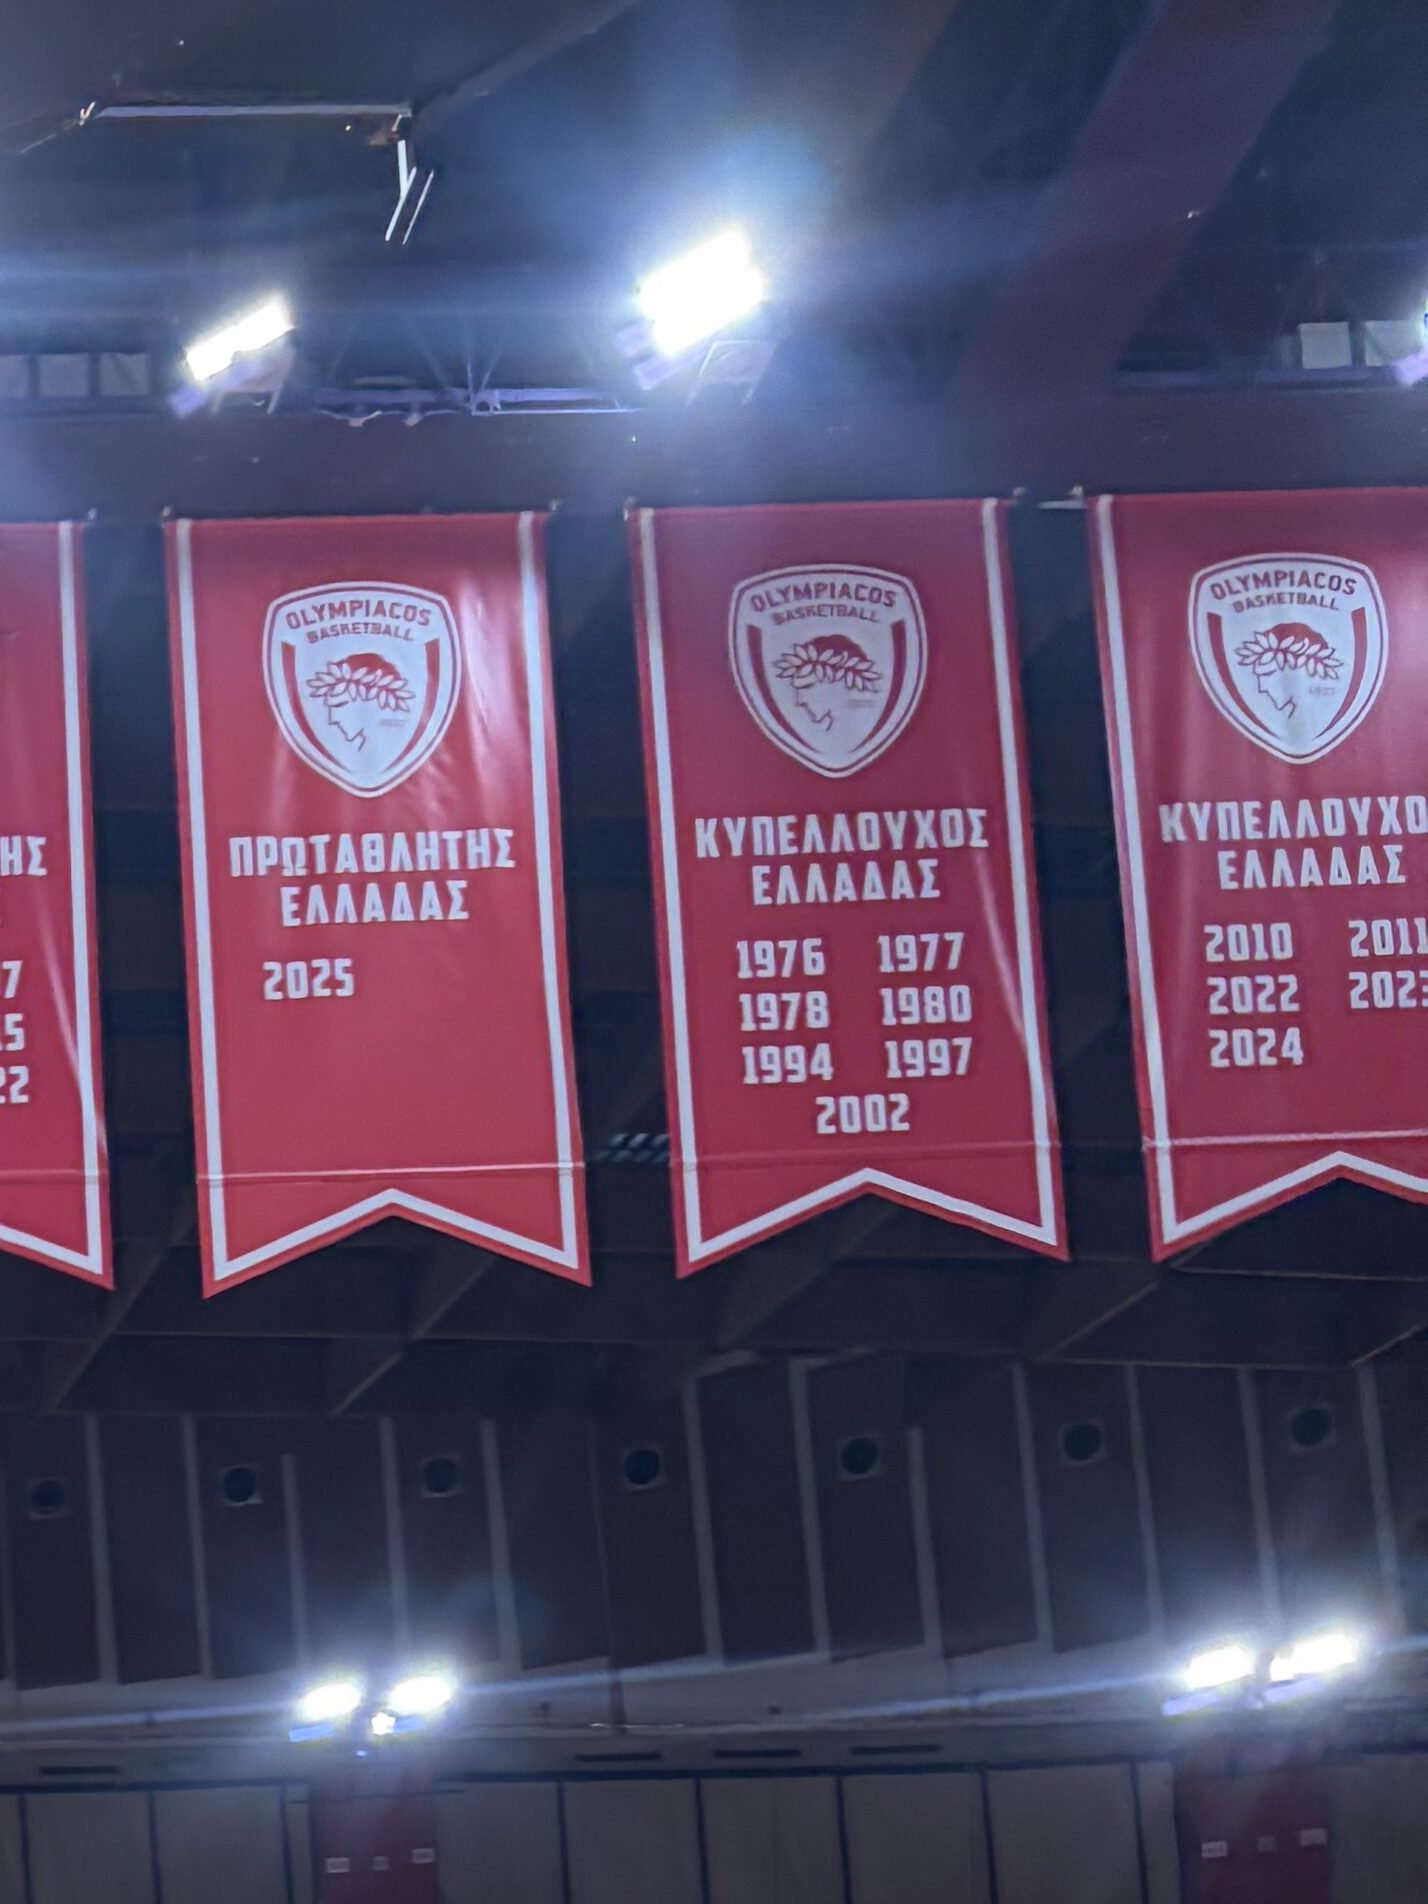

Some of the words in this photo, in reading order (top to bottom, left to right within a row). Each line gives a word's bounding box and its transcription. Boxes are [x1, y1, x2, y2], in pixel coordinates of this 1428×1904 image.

[750, 582, 897, 612] OLYMPIACOS
[1210, 569, 1357, 600] OLYMPIACOS
[286, 600, 431, 630] OLYMPIACOS
[229, 828, 516, 877] ΠΡΩΤΑΘΛΗΤΗΣ
[695, 808, 989, 858] ΚΥΠΕΛΛΟΥΧΟΣ
[751, 858, 940, 905] ΕΛΛΑΔΑΣ
[1218, 844, 1406, 890] ΕΛΛΑΔΑΣ
[280, 880, 469, 927] ΕΛΛΑΔΑΣ
[737, 937, 825, 978] 1976
[878, 931, 965, 973] 1977
[1204, 922, 1293, 962] 2010
[1348, 917, 1428, 957] 2011
[263, 958, 354, 1001] 2025
[1207, 974, 1299, 1015] 2022
[739, 990, 829, 1031] 1978
[880, 984, 972, 1026] 1980
[742, 1042, 834, 1085] 1994
[885, 1037, 972, 1078] 1997
[1208, 1027, 1303, 1067] 2024
[816, 1093, 910, 1134] 2002
